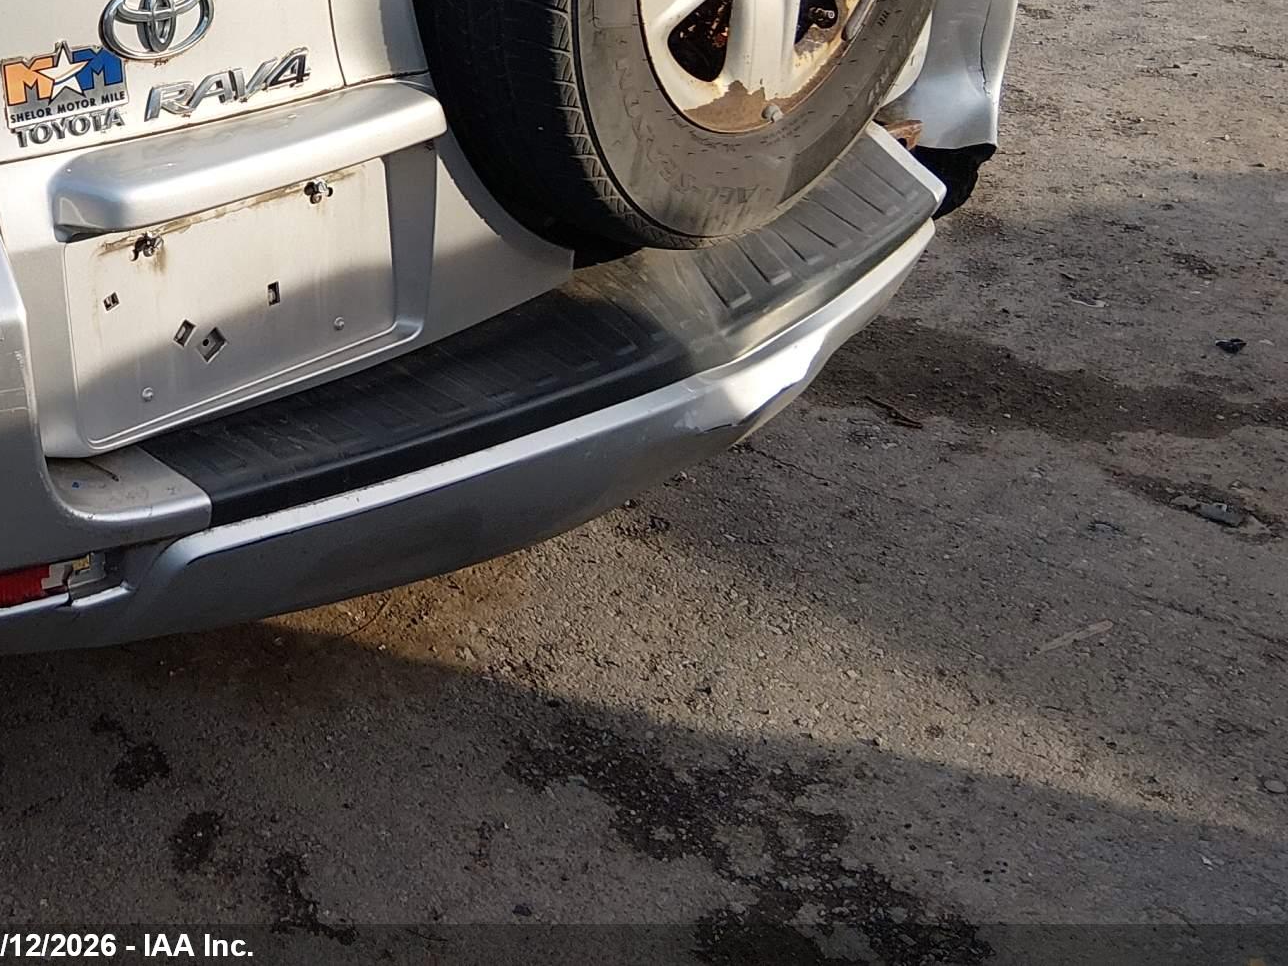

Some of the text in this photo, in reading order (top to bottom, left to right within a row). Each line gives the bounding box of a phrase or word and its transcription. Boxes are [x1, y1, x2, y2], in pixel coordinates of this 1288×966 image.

[143, 47, 311, 122] RAV4
[9, 90, 126, 124] SHELOR MOTOR MILE
[15, 108, 125, 148] TOYOTA
